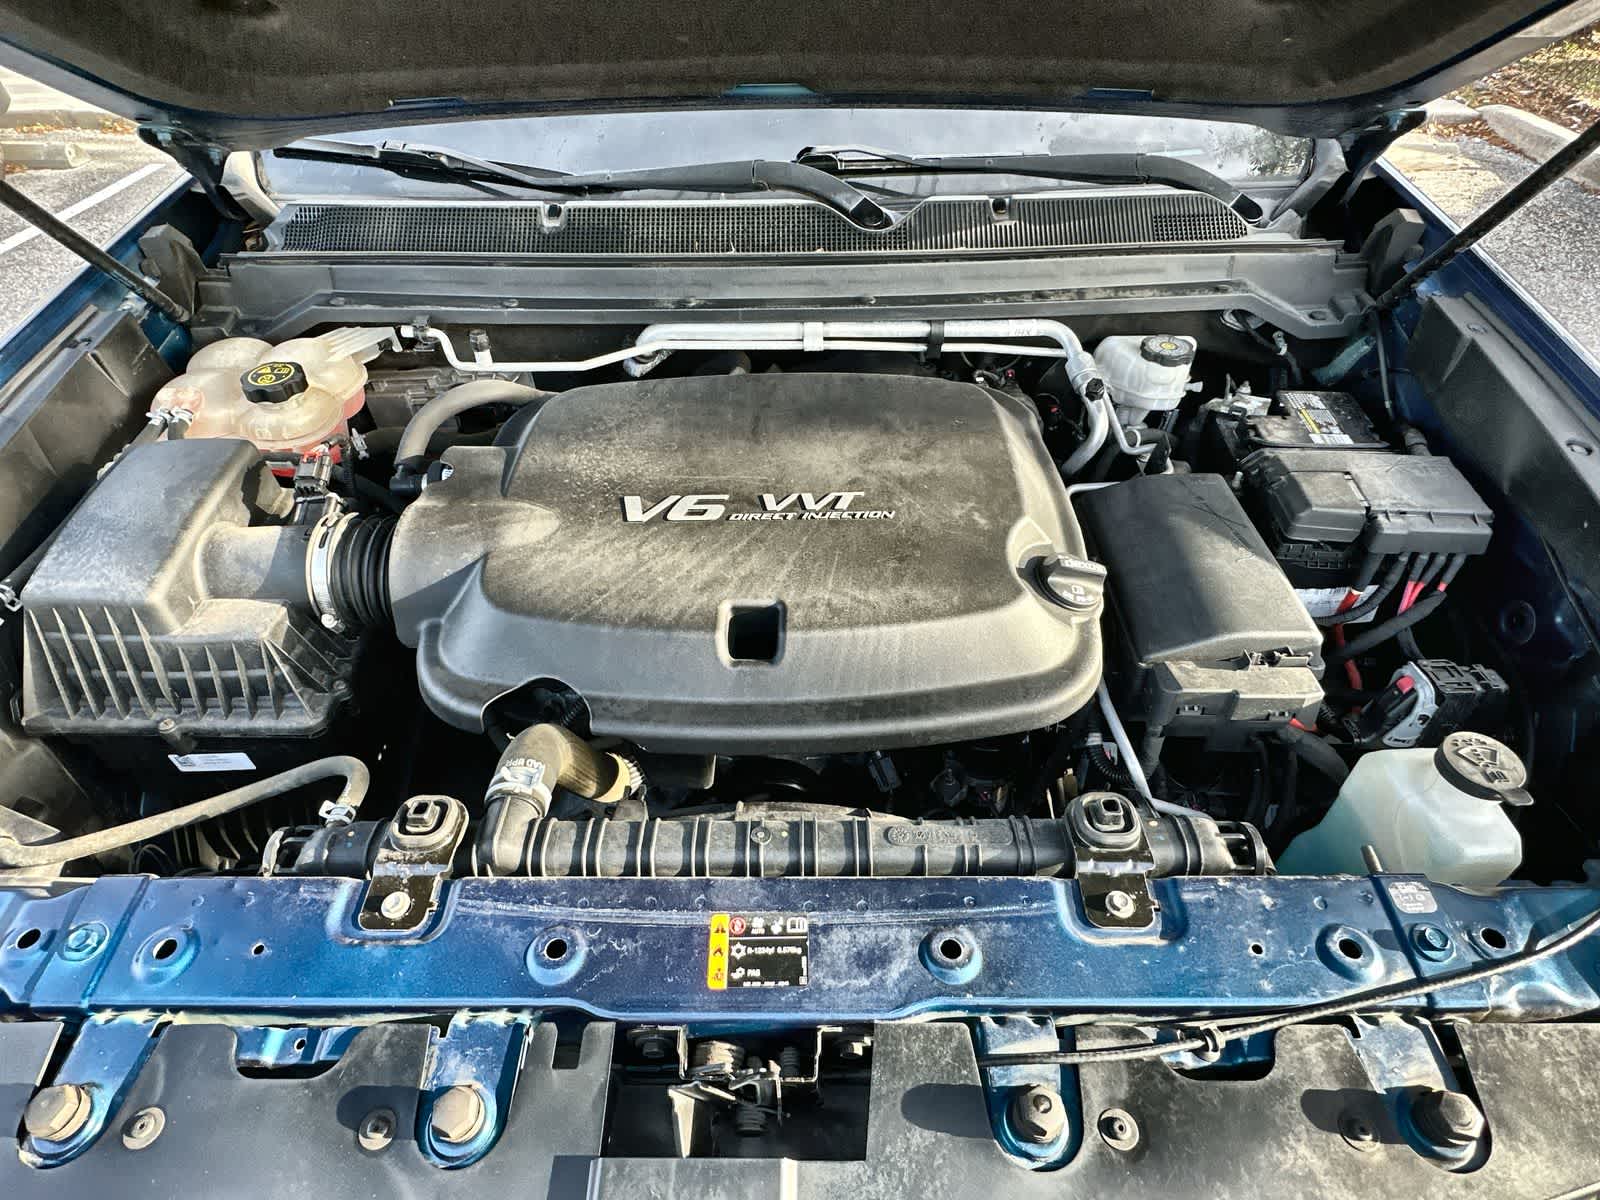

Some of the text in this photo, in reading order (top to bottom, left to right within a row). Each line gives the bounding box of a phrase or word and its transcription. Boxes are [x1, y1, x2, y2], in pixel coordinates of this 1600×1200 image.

[623, 491, 865, 523] V6 VVT
[728, 510, 896, 521] DIRECT INJECTION
